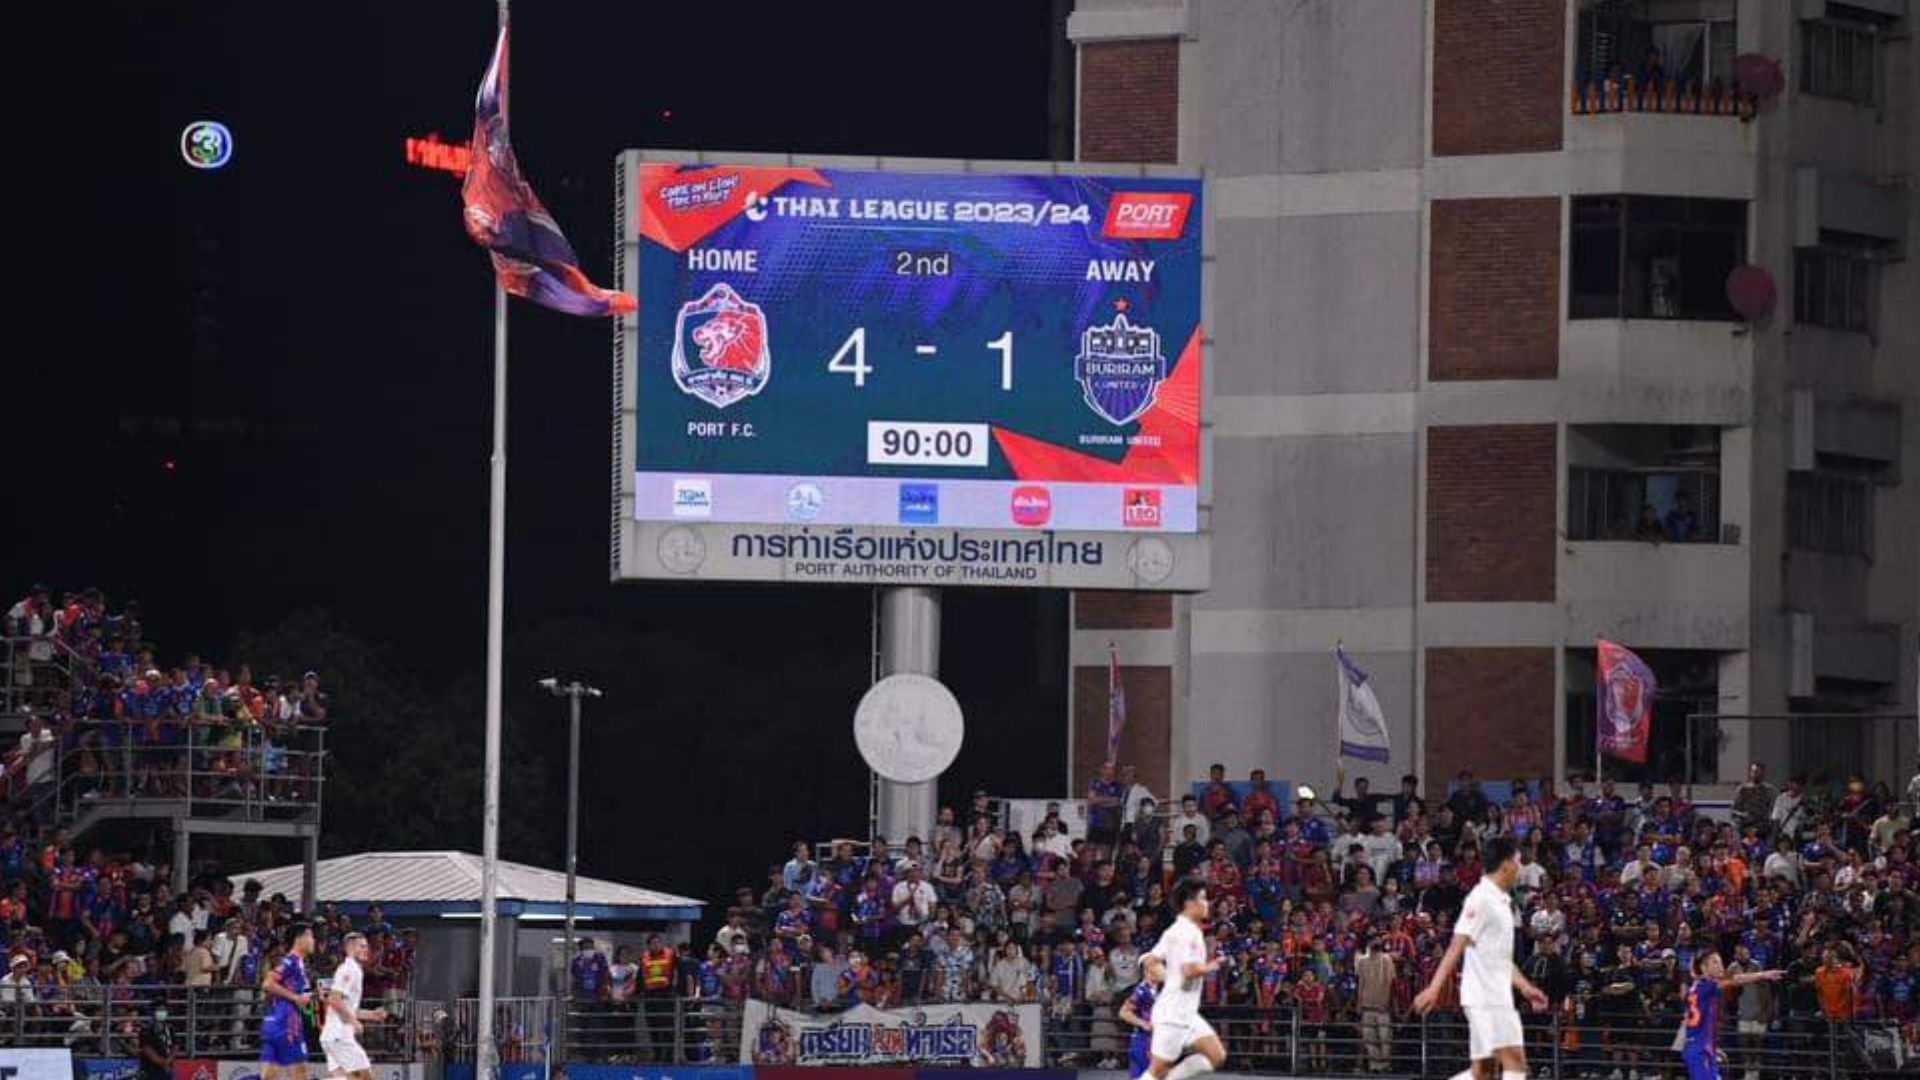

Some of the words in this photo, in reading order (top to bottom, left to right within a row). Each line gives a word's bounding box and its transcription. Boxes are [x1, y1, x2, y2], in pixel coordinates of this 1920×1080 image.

[774, 198, 840, 217] THAI
[850, 199, 949, 220] LEAGUE
[953, 201, 1091, 226] 2023/24
[1117, 203, 1179, 220] PORT
[688, 250, 758, 272] HOME
[897, 251, 949, 275] 2nd
[1086, 260, 1155, 283] AWAY
[828, 327, 872, 386] 4
[987, 331, 1012, 390] 1
[1086, 363, 1155, 375] BURIRAM
[687, 422, 724, 436] PORT
[731, 422, 757, 437] F.C.
[1079, 435, 1122, 445] BURIRAM
[1126, 435, 1161, 446] UNITED
[882, 429, 972, 457] 90:00
[1128, 507, 1156, 520] LEO
[732, 527, 1102, 565] การท่าเรือแห่งประเทศไทย
[795, 562, 835, 575] PORT
[843, 564, 928, 577] AUTHORITY
[934, 565, 955, 577] OF
[961, 566, 1036, 580] THAILAND
